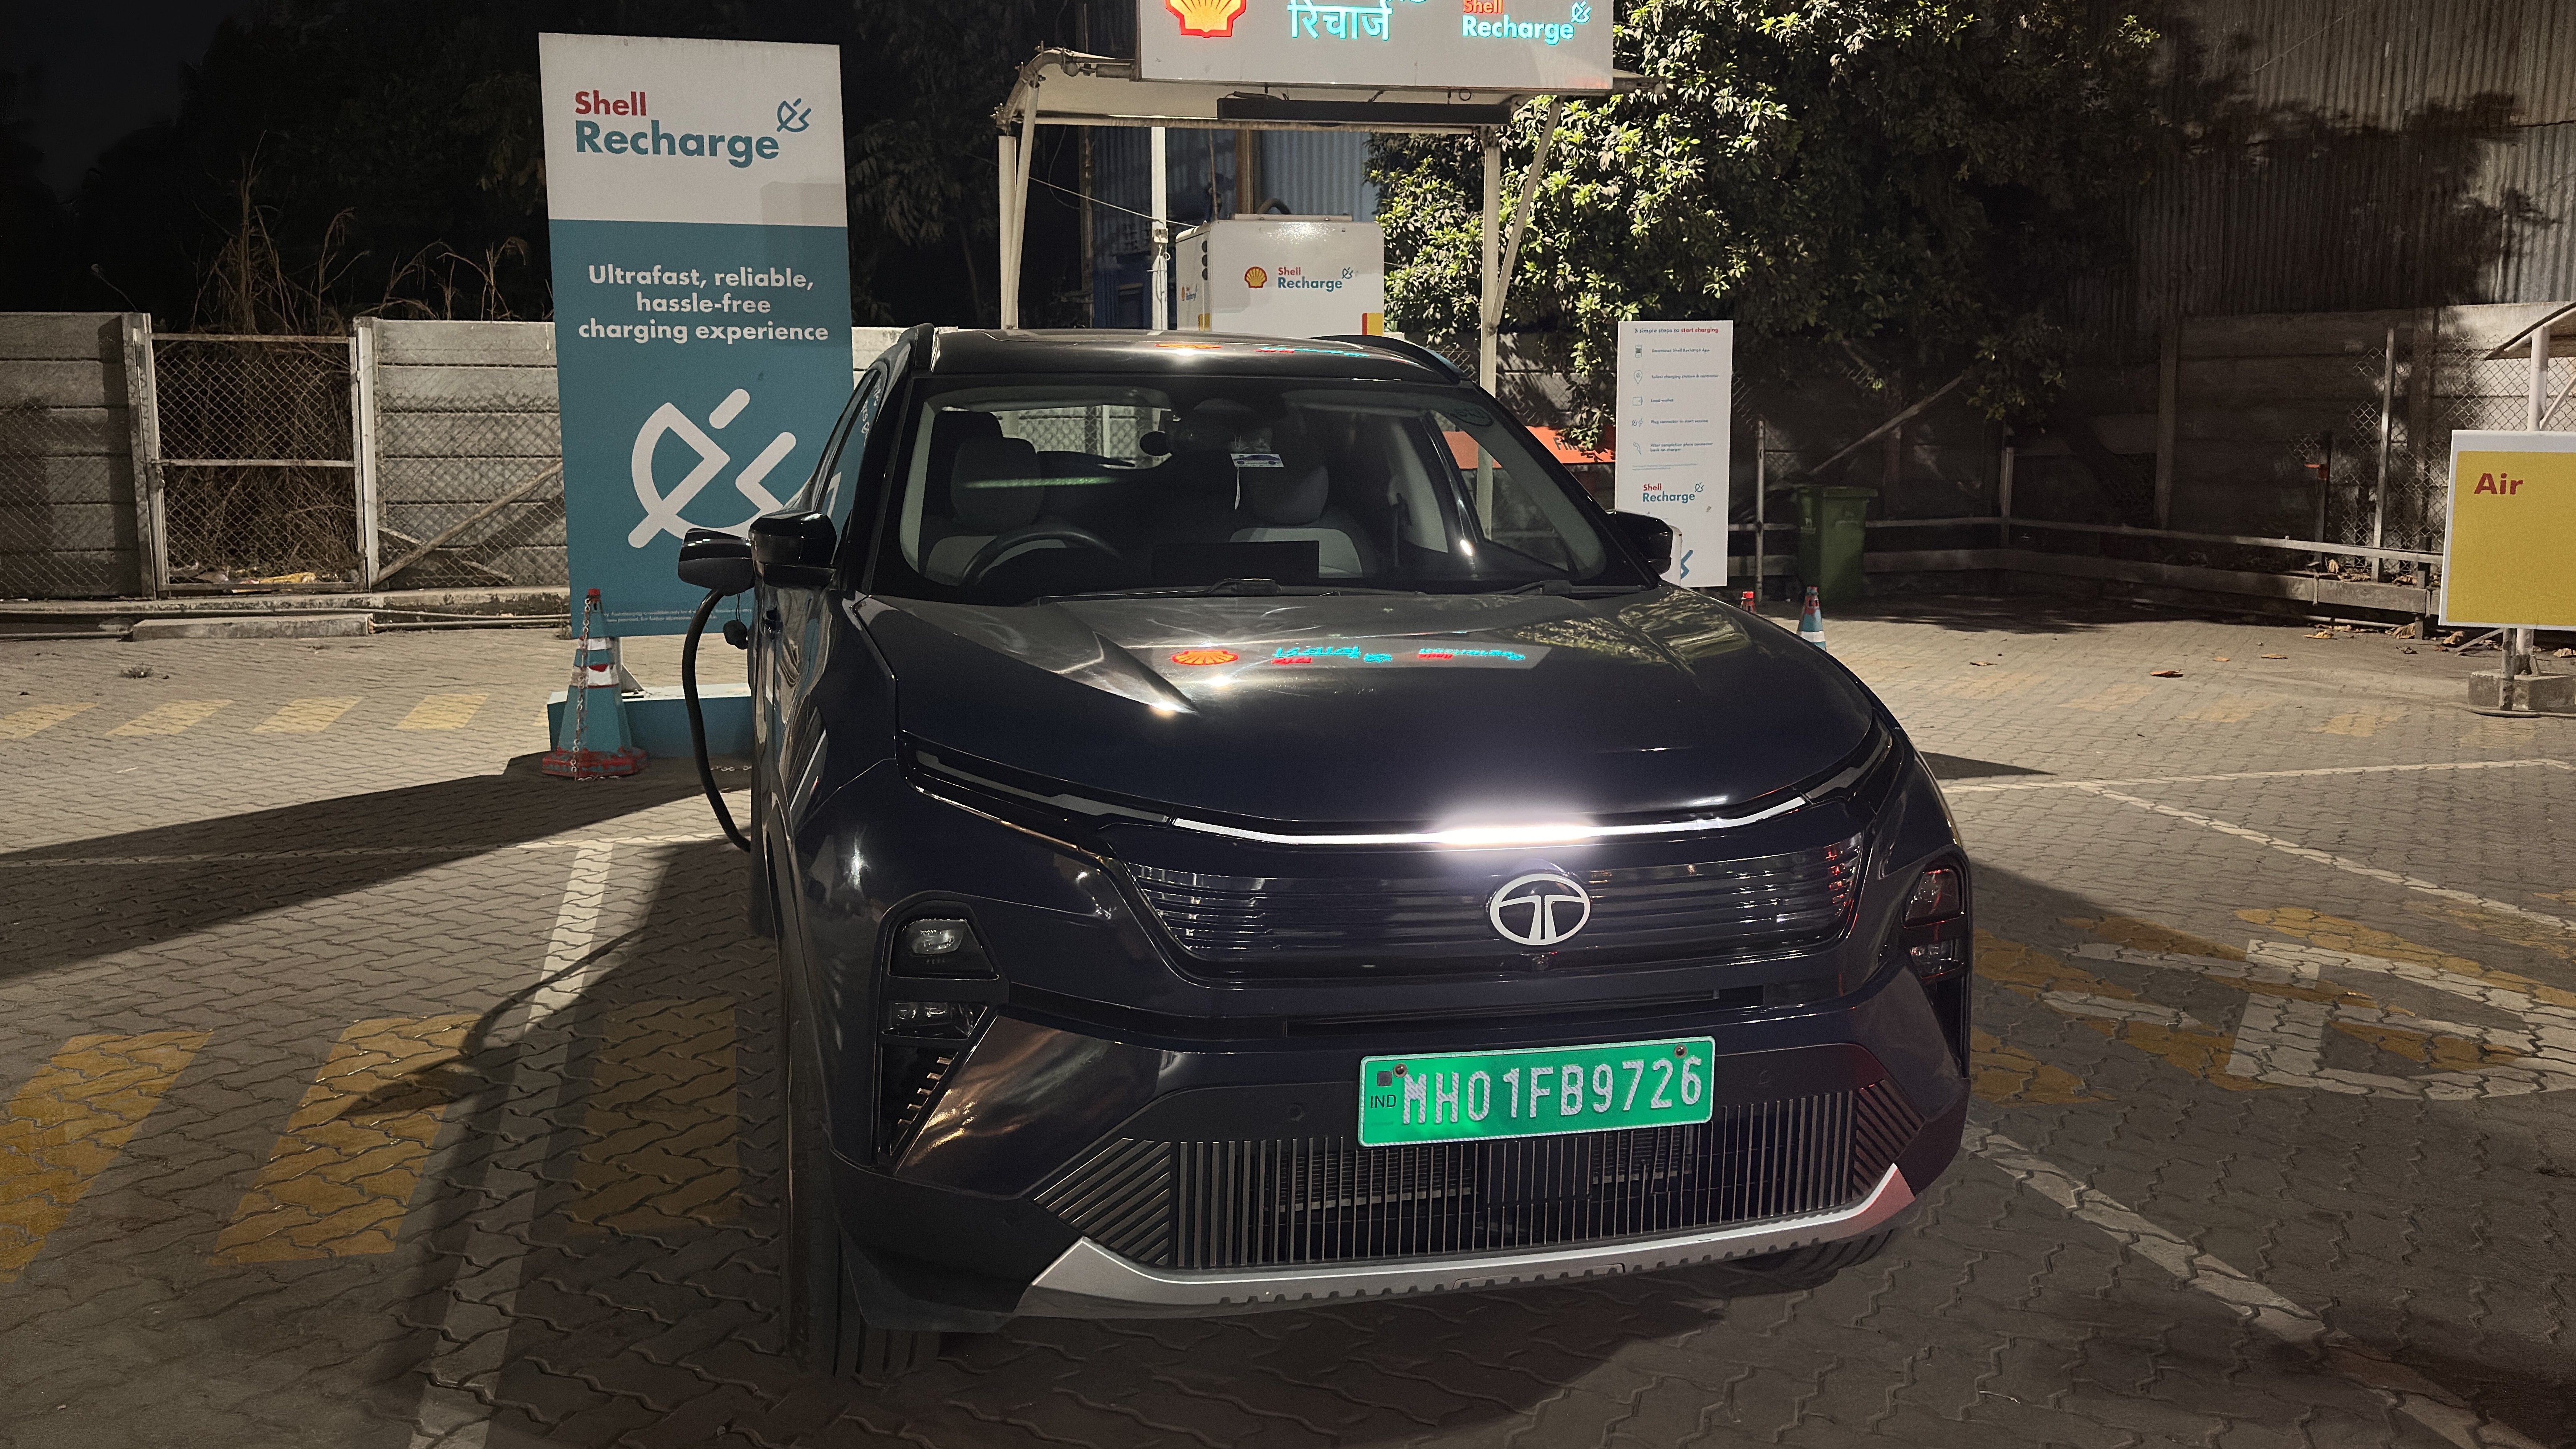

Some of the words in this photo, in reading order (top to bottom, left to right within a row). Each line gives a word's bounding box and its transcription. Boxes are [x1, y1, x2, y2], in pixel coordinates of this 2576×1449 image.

[1463, 0, 1503, 13] Shell
[1462, 15, 1575, 45] Recharge
[575, 90, 646, 116] Shell
[576, 120, 779, 168] Recharge
[589, 264, 706, 288] Ultrafast,
[715, 267, 813, 290] reliable,
[1278, 267, 1301, 276] Shell
[1278, 276, 1343, 292] Recharge
[637, 292, 770, 313] hassle-free
[579, 318, 687, 344] charging
[696, 321, 828, 344] experience
[2474, 473, 2523, 495] Air
[1643, 491, 1695, 504] Recharge
[1371, 1095, 1397, 1108] IND
[1403, 1056, 1702, 1125] MH01FB9726
